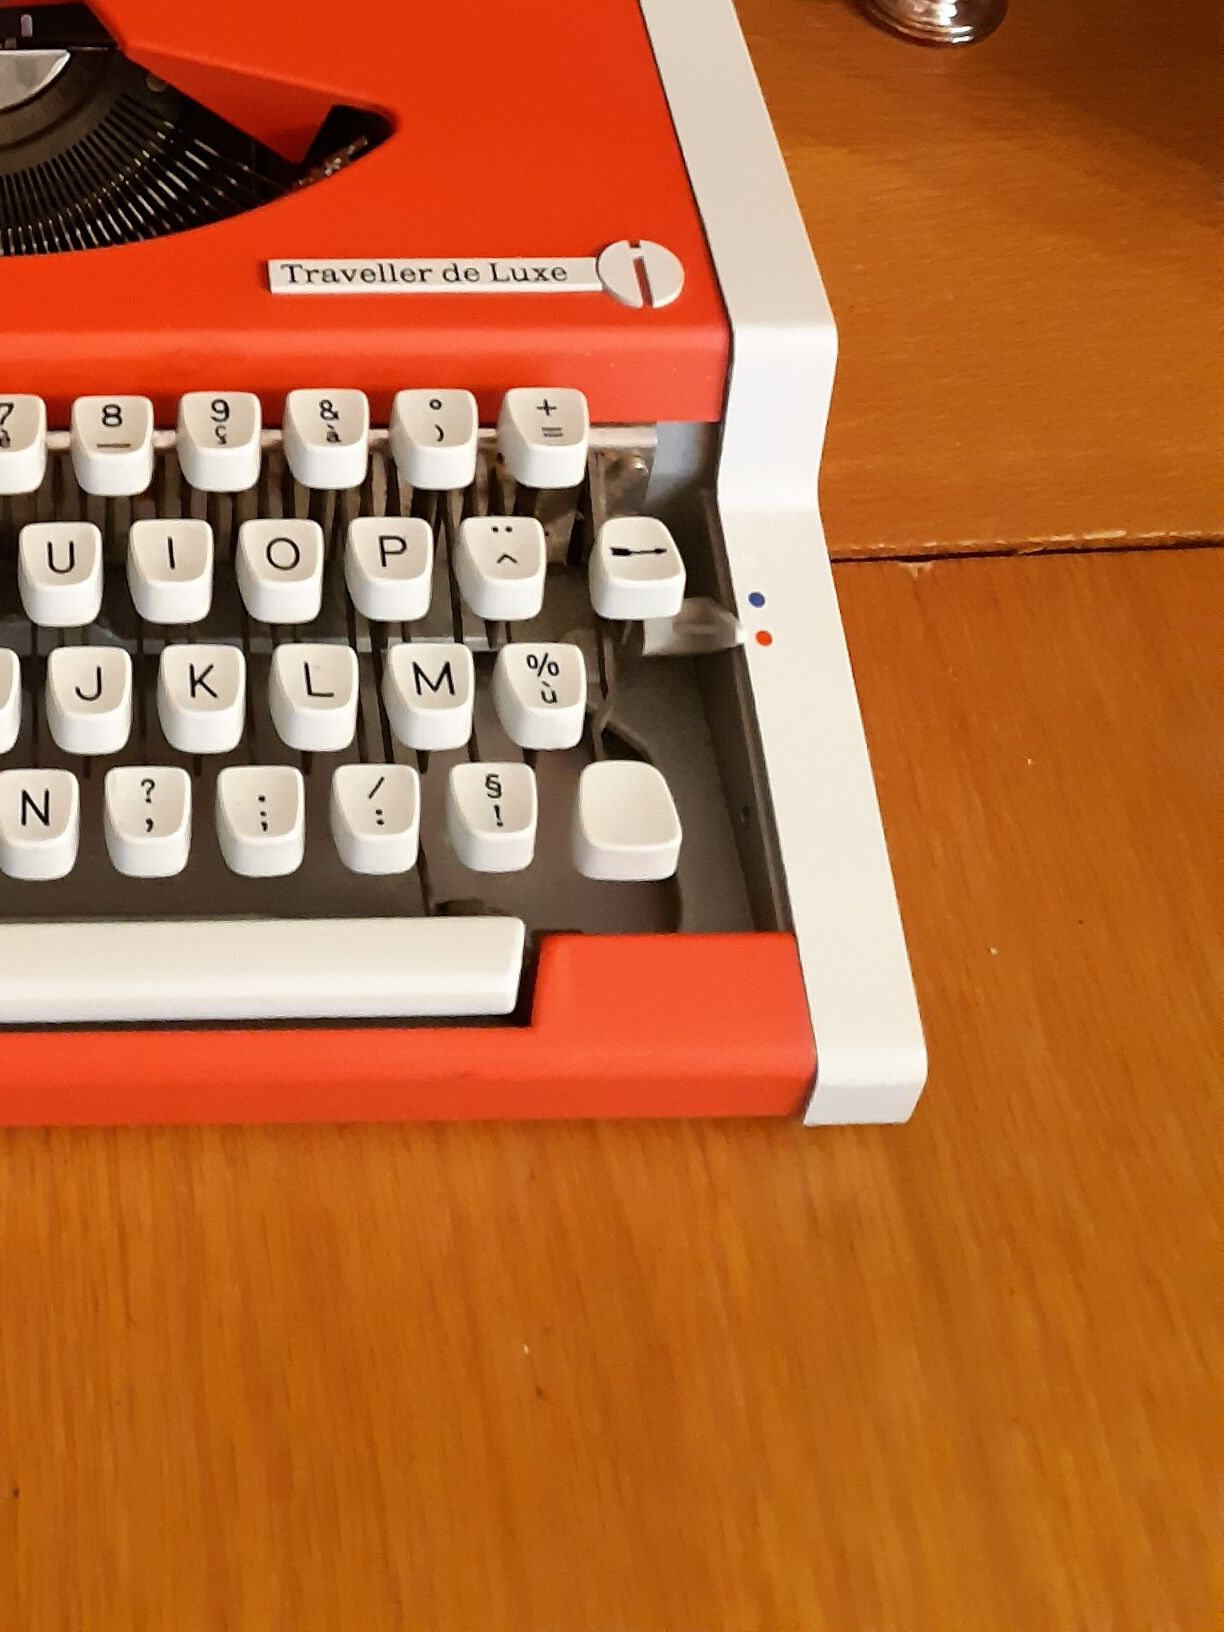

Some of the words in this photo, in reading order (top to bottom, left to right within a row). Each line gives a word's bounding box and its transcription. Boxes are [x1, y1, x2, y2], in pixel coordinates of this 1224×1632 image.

[281, 264, 432, 283] Traveller
[443, 263, 479, 282] de
[490, 263, 566, 282] Luxe
[101, 403, 123, 428] 8
[210, 398, 230, 423] 9
[318, 399, 340, 421] &
[536, 399, 558, 417] +
[434, 424, 445, 443] )
[541, 426, 564, 438] =
[47, 540, 76, 575] U
[265, 537, 301, 572] O
[378, 535, 408, 568] P
[526, 652, 560, 678] %
[75, 666, 103, 702] J
[189, 663, 218, 699] K
[303, 662, 335, 698] L
[412, 661, 456, 696] M
[540, 681, 558, 704] ù
[140, 778, 156, 804] ?
[484, 773, 503, 799] §
[20, 789, 50, 827] N
[493, 804, 504, 828] !
